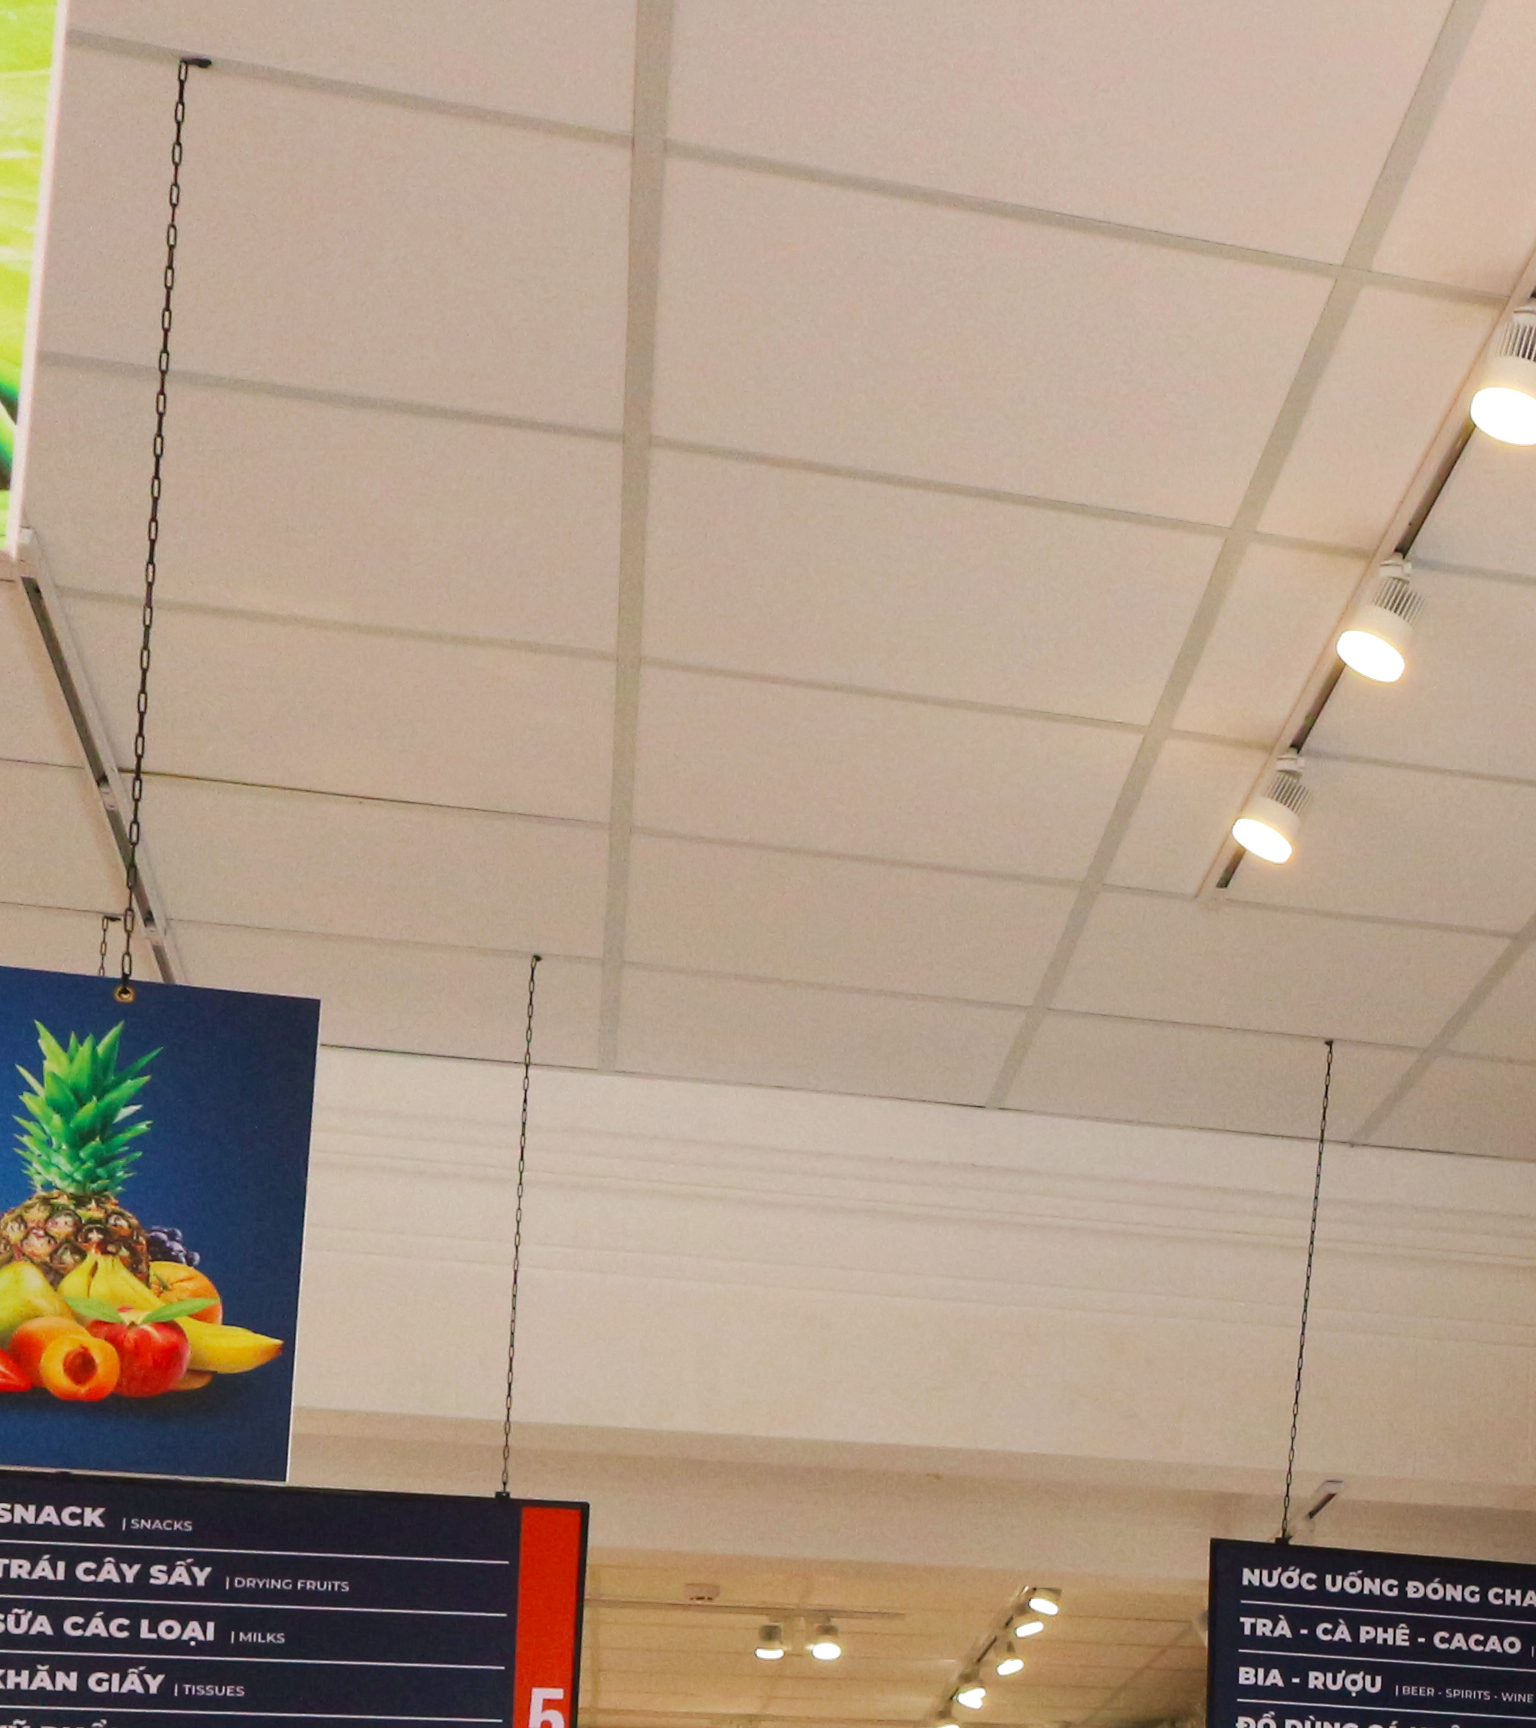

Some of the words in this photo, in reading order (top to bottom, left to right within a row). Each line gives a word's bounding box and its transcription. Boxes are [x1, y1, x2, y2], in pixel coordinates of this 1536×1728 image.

[0, 1503, 106, 1528] SNACK
[130, 1518, 193, 1532] SNACKS
[75, 1557, 141, 1584] CÂY
[150, 1557, 212, 1587] SẤY
[234, 1577, 293, 1591] DRYING
[297, 1579, 350, 1592] FRUITS
[1241, 1566, 1318, 1593] NƯỚC
[1325, 1570, 1399, 1598] UỐNG
[1405, 1576, 1481, 1605] ĐÓNG
[63, 1611, 130, 1638] CÁC
[140, 1619, 215, 1647] LOẠI
[239, 1631, 285, 1644] MILKS
[1240, 1614, 1292, 1639] TRÀ
[1316, 1618, 1353, 1643] CÀ
[1359, 1622, 1410, 1647] PHÊ
[1433, 1630, 1522, 1655] CACAO
[88, 1666, 165, 1694] GIẤY
[183, 1684, 245, 1697] TISSUES
[1238, 1665, 1284, 1688] BIA
[1308, 1669, 1383, 1698] RƯỢU
[1403, 1684, 1435, 1697] BEER
[1445, 1687, 1491, 1701] SPIRITS
[1501, 1691, 1534, 1704] WINE
